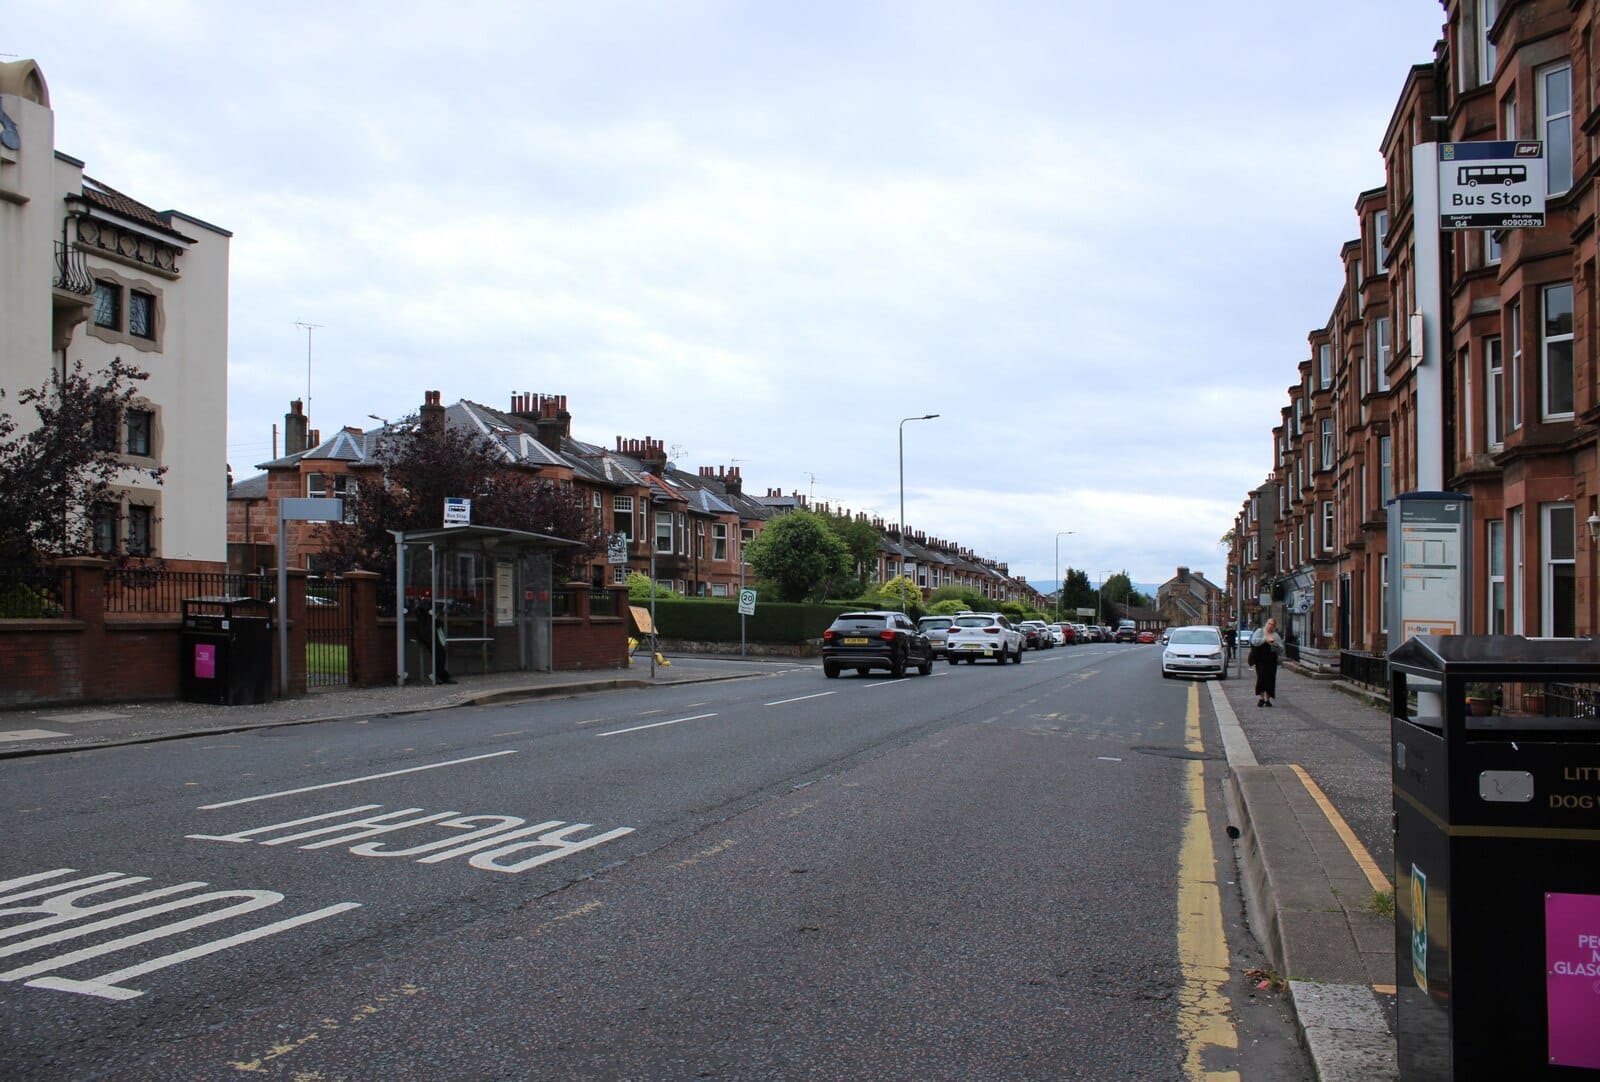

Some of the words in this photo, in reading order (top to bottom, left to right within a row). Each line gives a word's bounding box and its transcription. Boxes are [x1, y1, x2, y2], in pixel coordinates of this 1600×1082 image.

[1453, 193, 1485, 206] Bus
[1491, 192, 1532, 207] Stop
[743, 594, 753, 602] 20
[1549, 794, 1593, 808] DOG
[186, 804, 635, 873] RIGHT
[1578, 935, 1600, 948] PE
